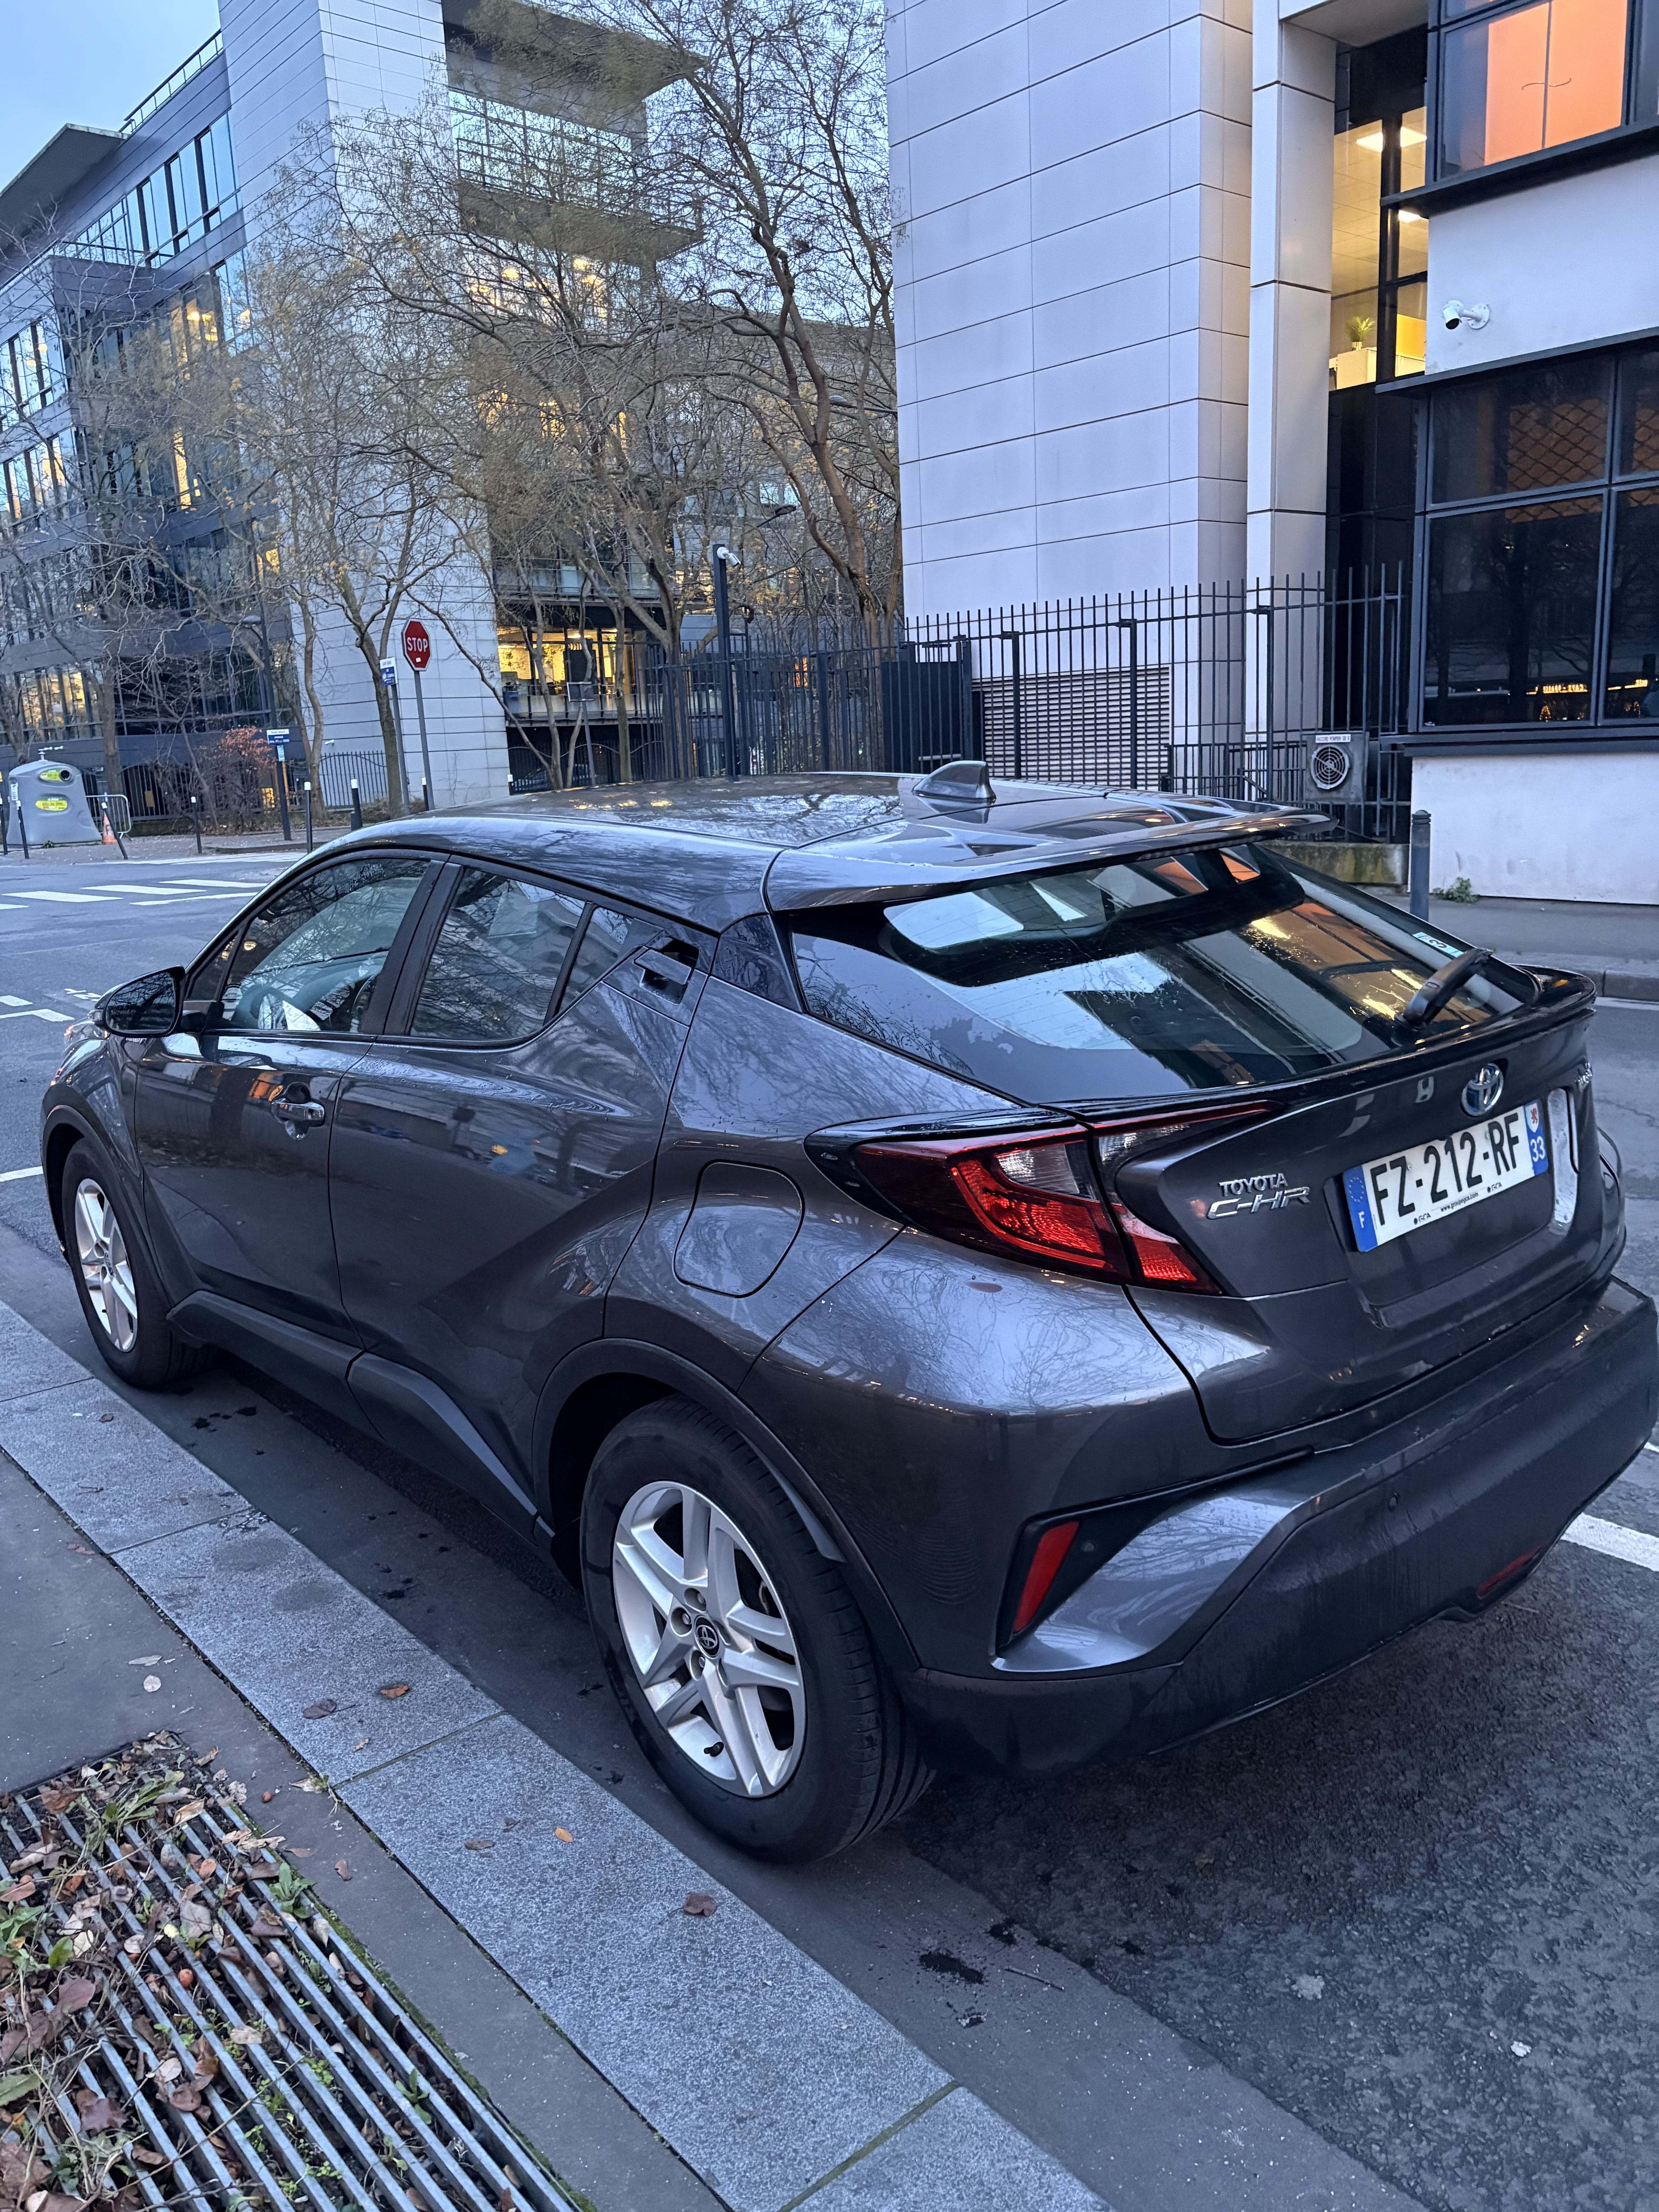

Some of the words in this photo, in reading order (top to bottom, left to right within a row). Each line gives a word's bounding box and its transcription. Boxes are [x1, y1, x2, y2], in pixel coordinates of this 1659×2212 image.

[407, 637, 428, 653] STOP
[1530, 1135, 1546, 1163] 33
[1370, 1112, 1519, 1226] FZ-212-RF
[1218, 1173, 1288, 1196] TOYOTA
[1207, 1187, 1311, 1219] C-HR
[1358, 1211, 1365, 1228] F
